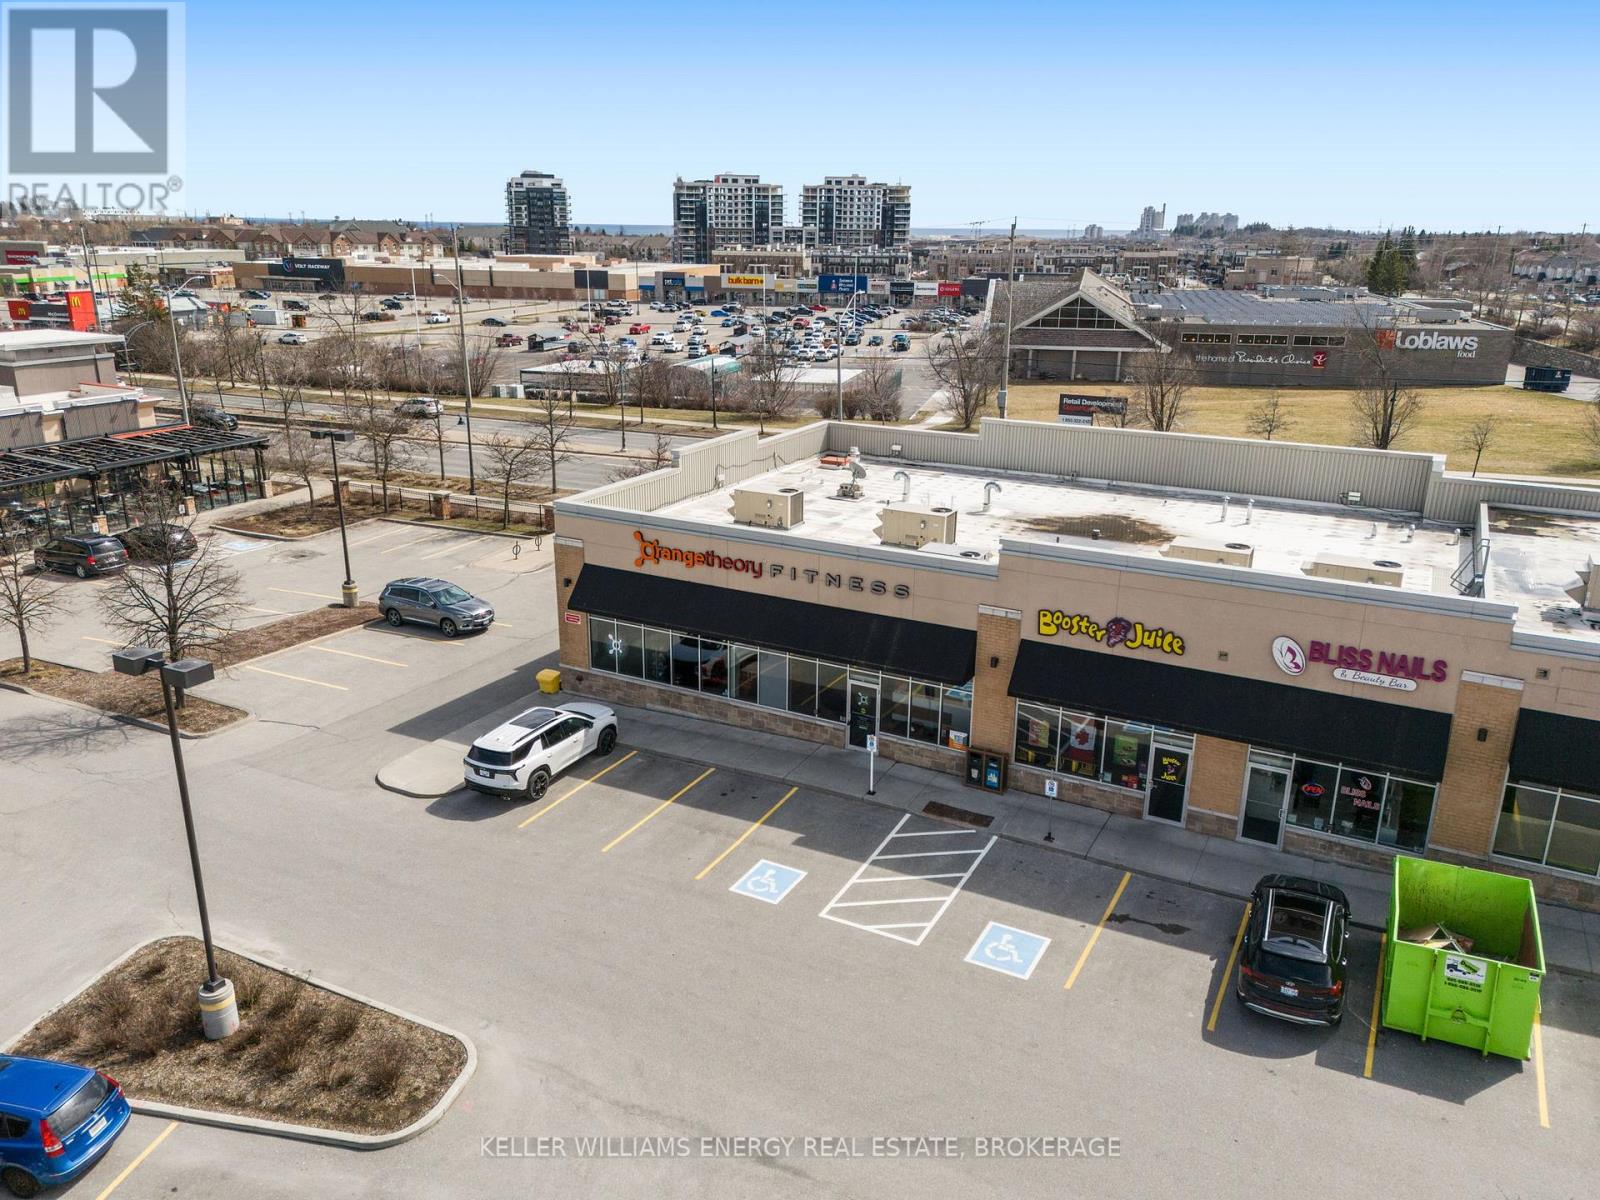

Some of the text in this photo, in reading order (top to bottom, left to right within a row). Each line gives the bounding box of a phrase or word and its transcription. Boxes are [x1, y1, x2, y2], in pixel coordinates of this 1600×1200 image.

[1395, 330, 1479, 351] Loblaws
[1457, 350, 1476, 359] food
[1063, 397, 1081, 405] Retail
[770, 564, 911, 599] FITNESS
[1038, 609, 1186, 655] Booster Juice
[1308, 640, 1448, 683] BLISS NAILS
[1339, 669, 1409, 690] & Beauty Bar
